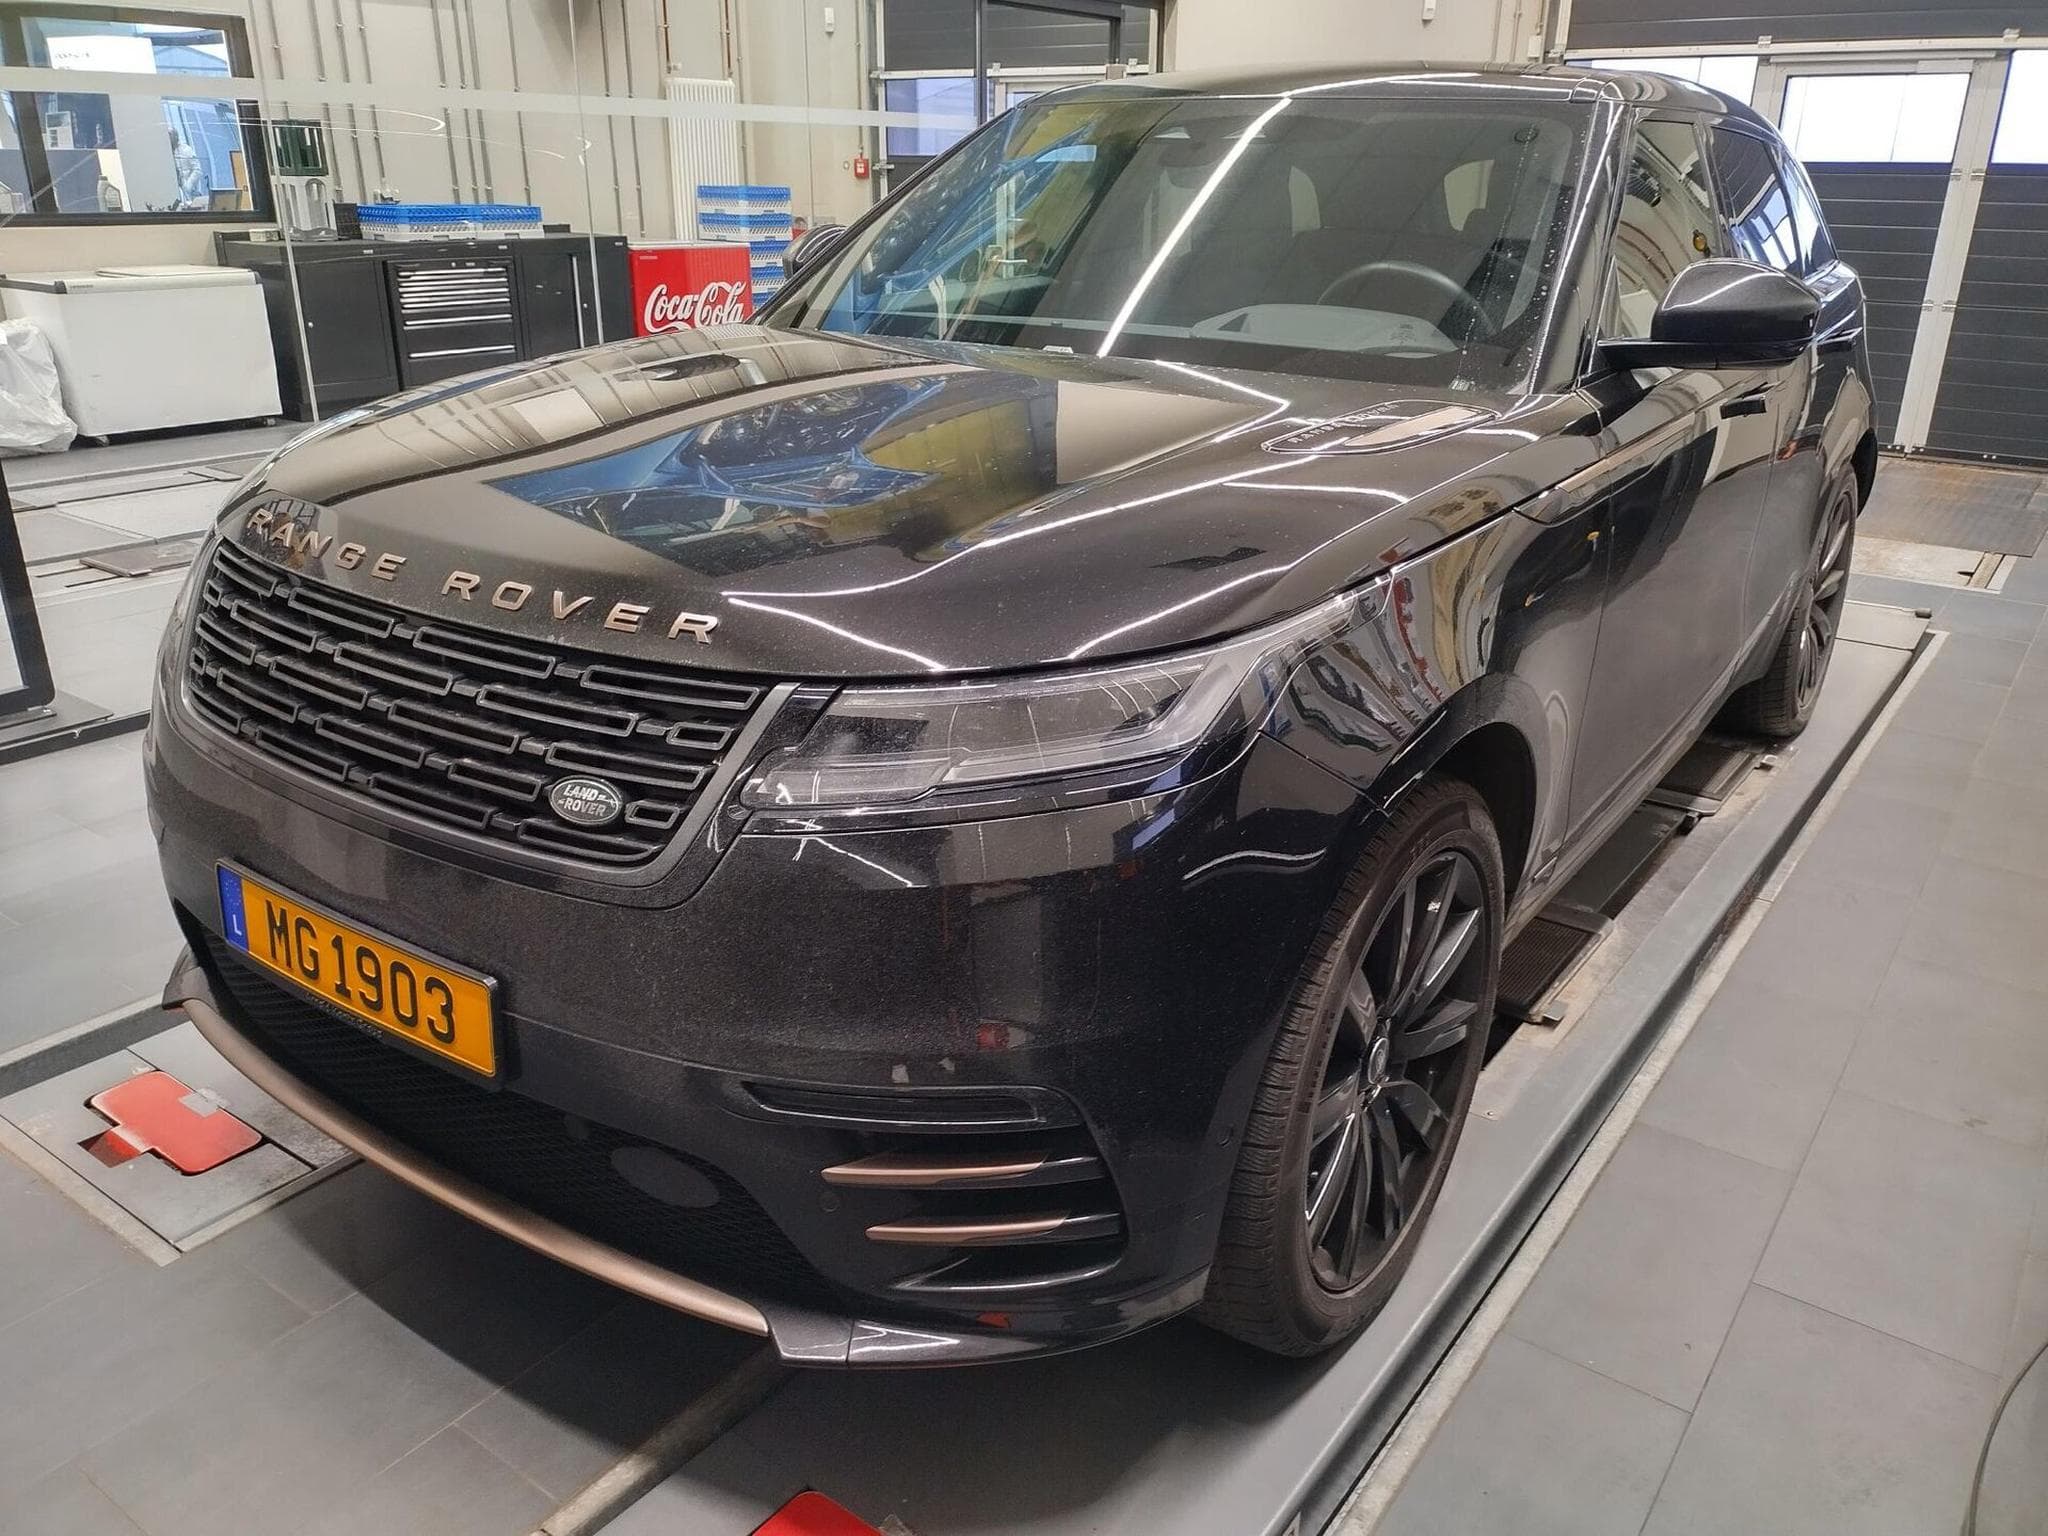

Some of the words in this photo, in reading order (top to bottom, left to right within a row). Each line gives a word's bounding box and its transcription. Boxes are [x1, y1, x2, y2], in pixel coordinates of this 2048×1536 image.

[644, 281, 747, 333] Coca-Cola
[247, 508, 408, 581] RANGE
[441, 570, 718, 644] ROVER
[232, 914, 242, 936] L
